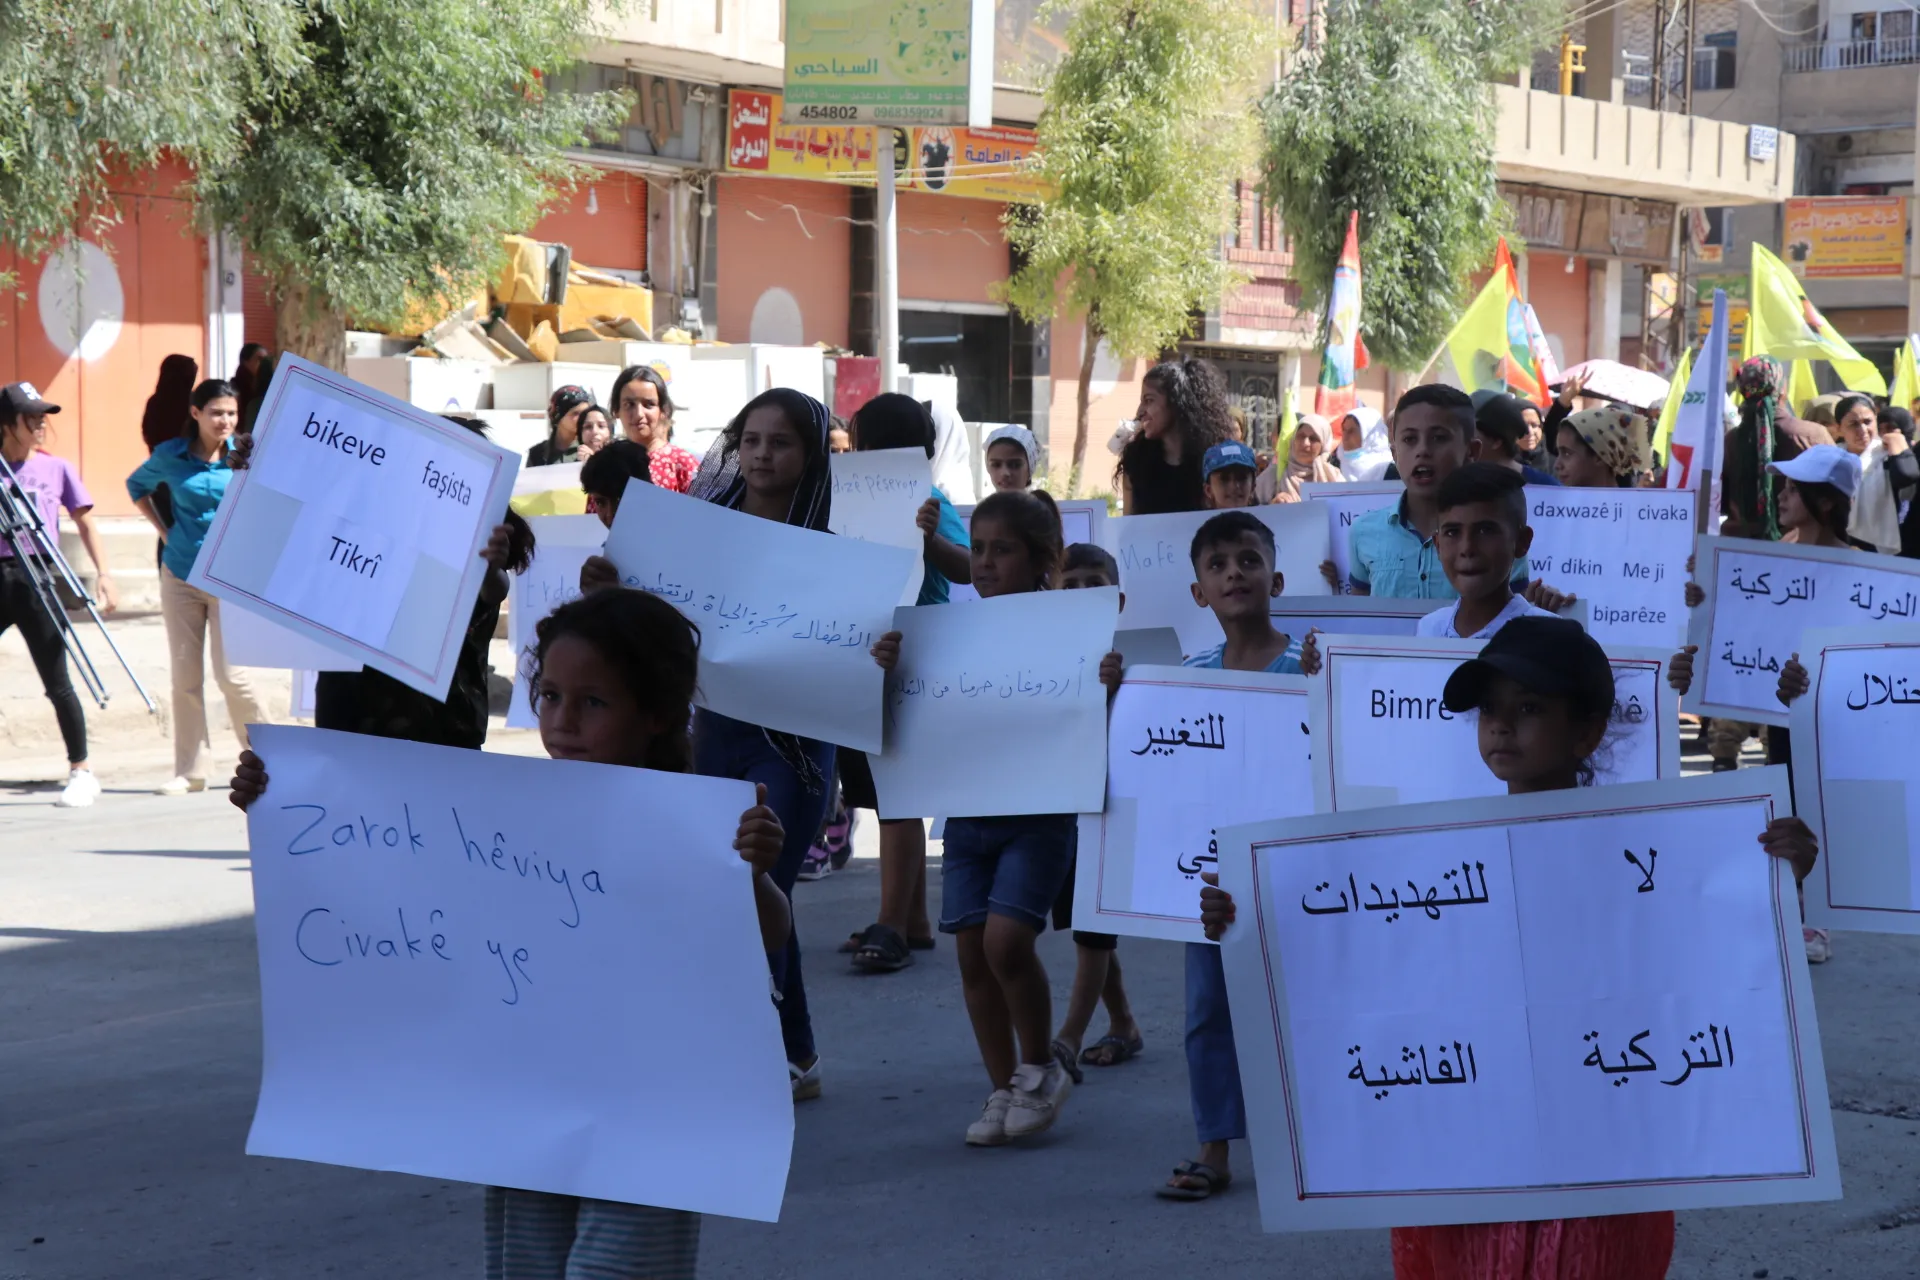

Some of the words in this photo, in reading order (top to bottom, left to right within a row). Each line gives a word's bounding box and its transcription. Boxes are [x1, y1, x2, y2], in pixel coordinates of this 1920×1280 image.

[794, 58, 878, 77] السياحي
[733, 97, 769, 128] للشحن
[800, 106, 858, 119] 454802
[731, 136, 768, 163] الدولي
[965, 144, 1010, 163] العامة
[302, 411, 387, 466] bikeve
[421, 459, 473, 506] faşista
[1534, 502, 1609, 519] daxwazê
[1613, 504, 1623, 522] ji
[1638, 505, 1688, 521] civaka
[328, 535, 383, 579] Tikrî
[1529, 556, 1552, 572] wî
[1561, 558, 1602, 576] dikin
[1623, 562, 1650, 579] Me
[1655, 563, 1665, 583] ji
[1731, 567, 1816, 606] التركية
[1849, 582, 1918, 621] الدولة
[1593, 605, 1667, 626] biparêze
[999, 655, 1087, 699] أردوغان
[1721, 640, 1780, 676] هابية
[931, 681, 950, 699] من
[1130, 712, 1226, 757] للتغيير
[281, 803, 425, 855] Zarok
[452, 807, 606, 929] hêviya
[1624, 847, 1658, 893] لا
[1301, 860, 1489, 924] للتهديدات
[296, 907, 453, 966] Civakê
[487, 939, 533, 1006] ye
[1347, 1039, 1478, 1101] الفاشية
[1583, 1023, 1734, 1087] التركية
